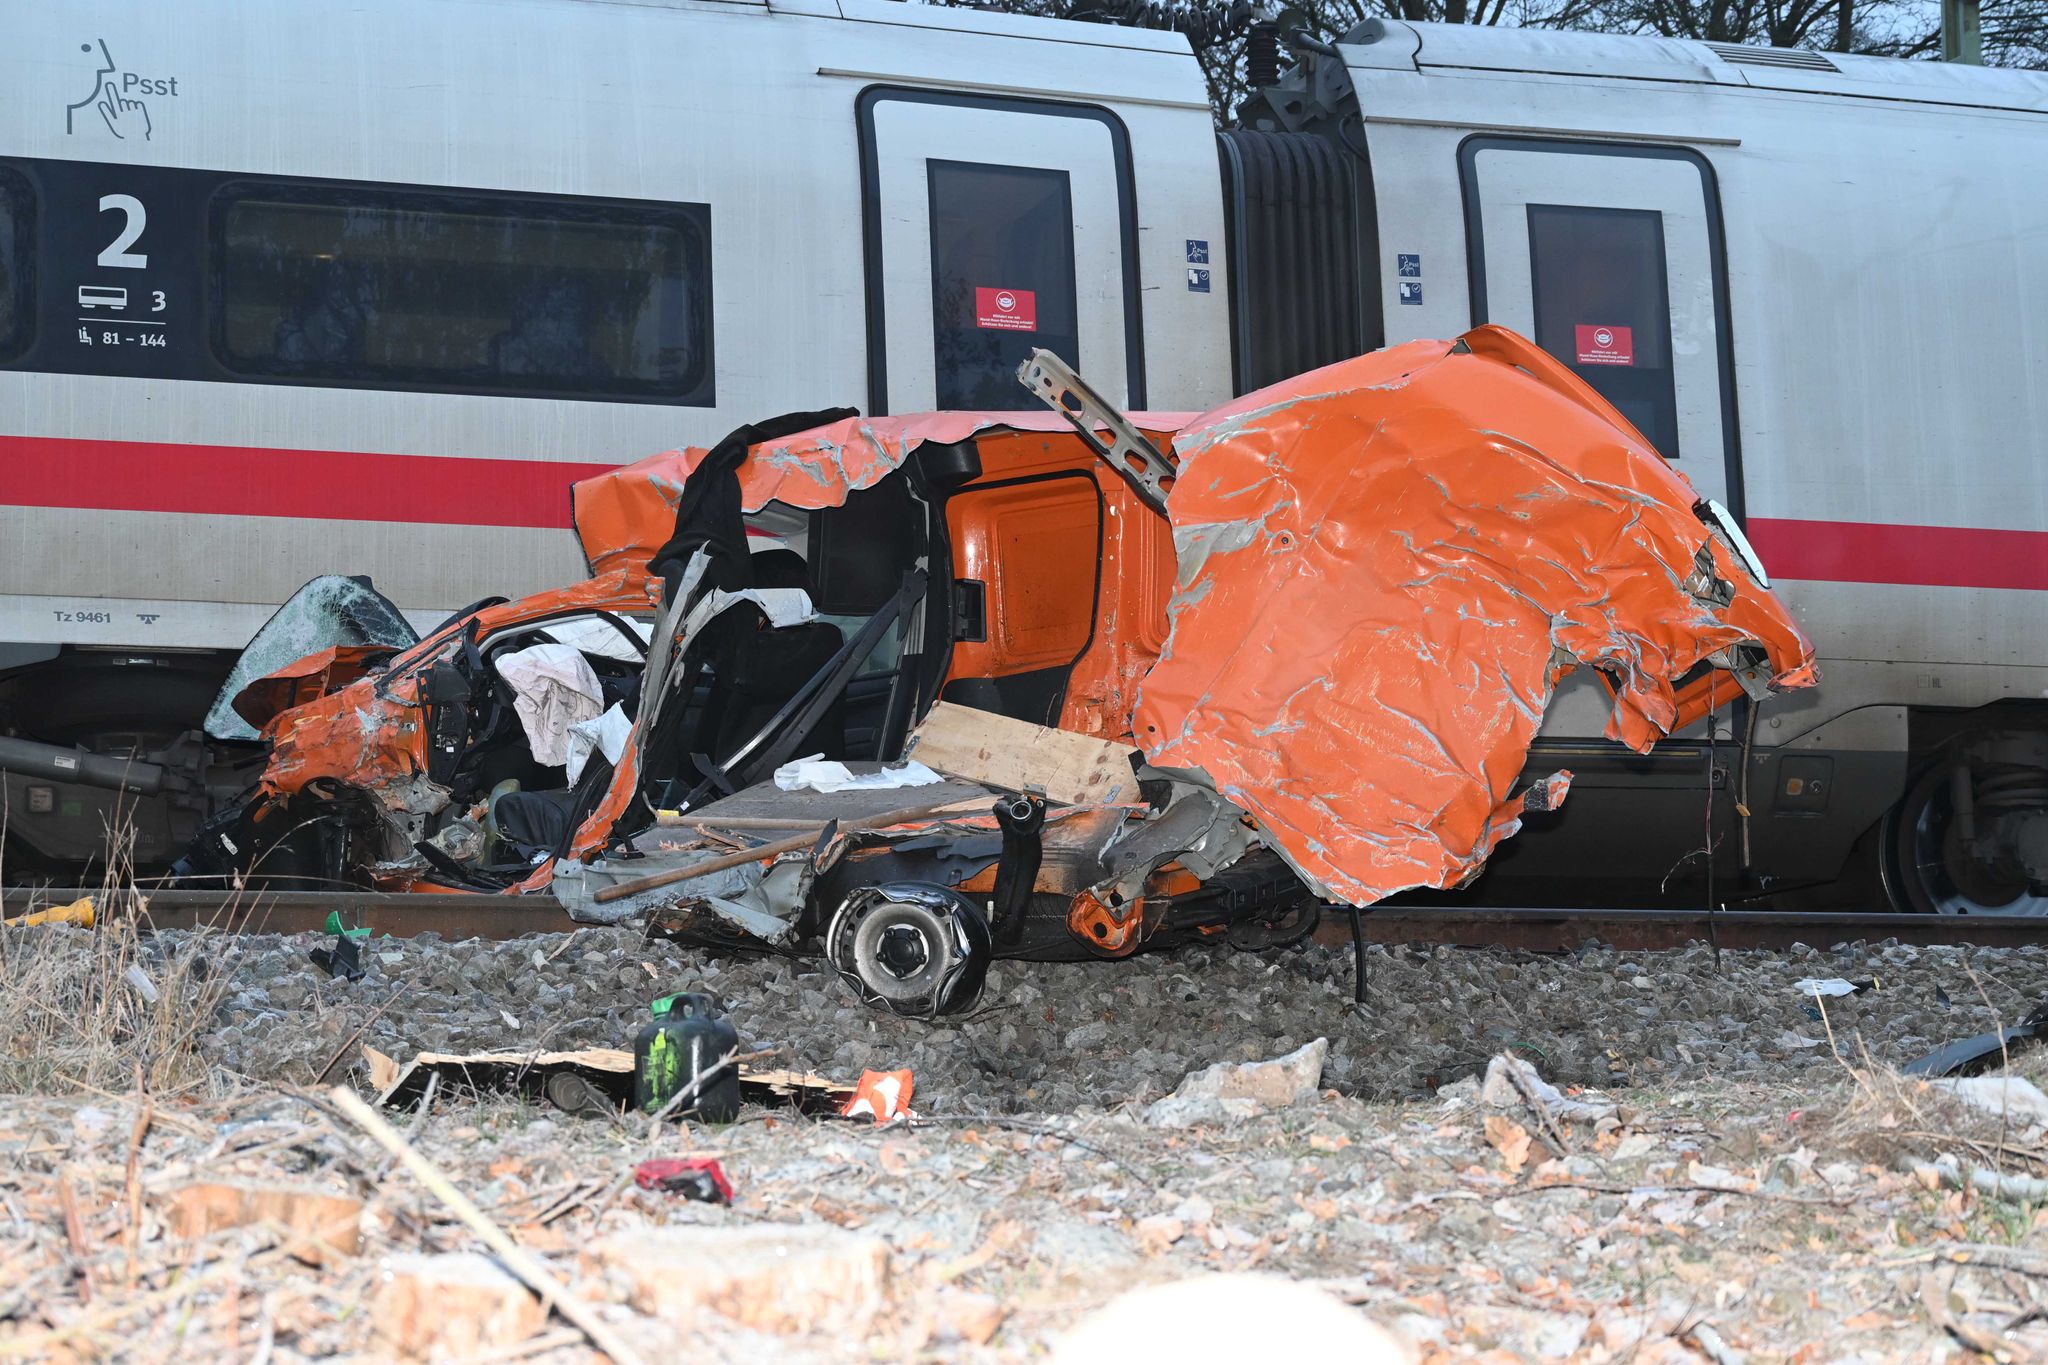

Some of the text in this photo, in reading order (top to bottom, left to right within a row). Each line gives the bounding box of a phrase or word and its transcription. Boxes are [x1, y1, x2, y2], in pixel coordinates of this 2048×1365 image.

[122, 72, 179, 97] Psst
[97, 193, 148, 269] 2
[151, 290, 167, 312] 3
[102, 332, 121, 346] 81
[140, 333, 167, 348] 144
[53, 611, 111, 624] Tz 9461
